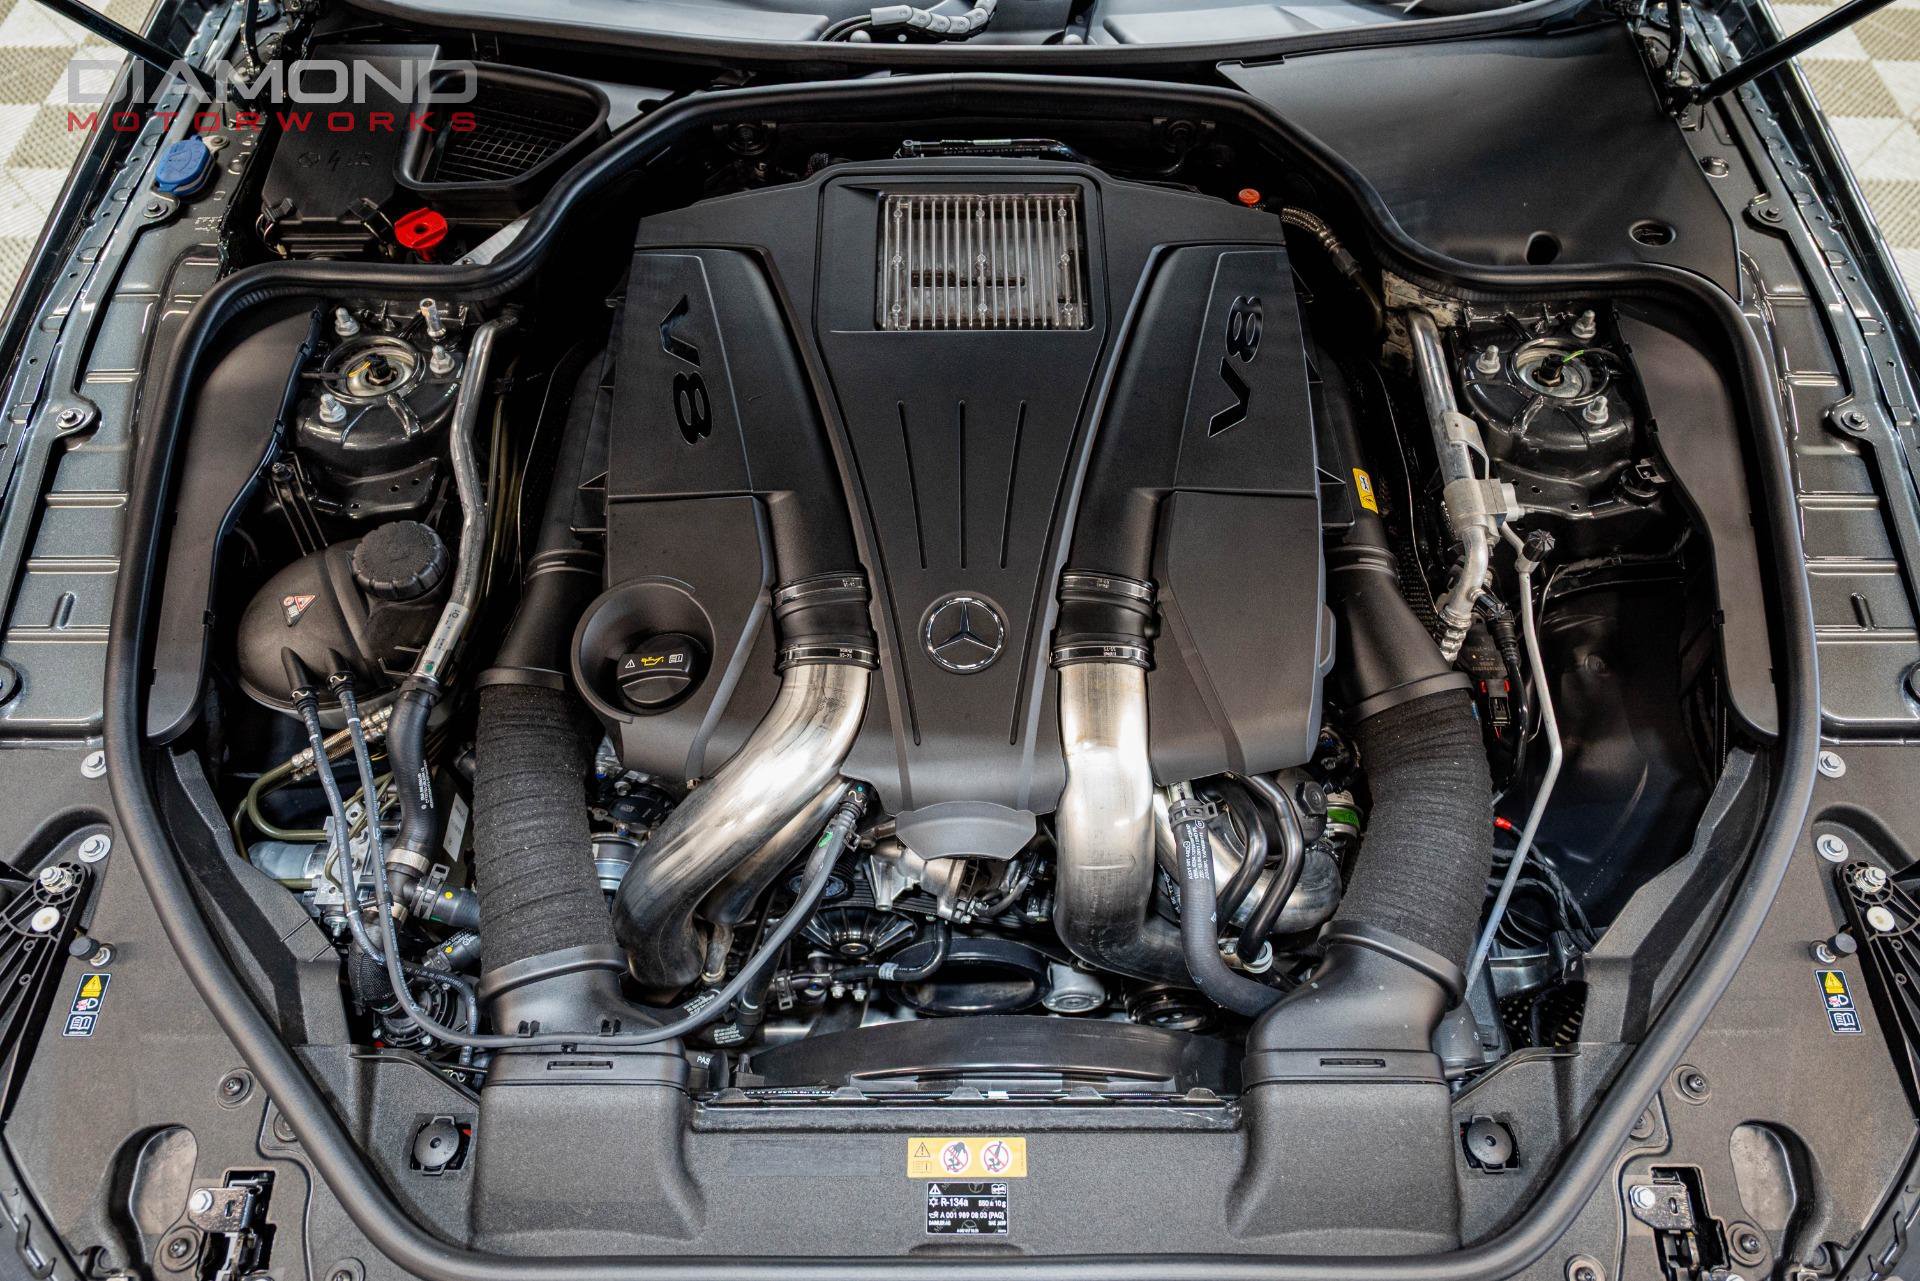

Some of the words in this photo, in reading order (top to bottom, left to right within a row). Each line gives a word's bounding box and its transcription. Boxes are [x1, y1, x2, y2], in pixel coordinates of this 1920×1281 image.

[658, 293, 713, 446] V8
[1207, 295, 1264, 439] V8
[940, 1197, 969, 1207] R-134a
[988, 1211, 1005, 1220] (PAG)
